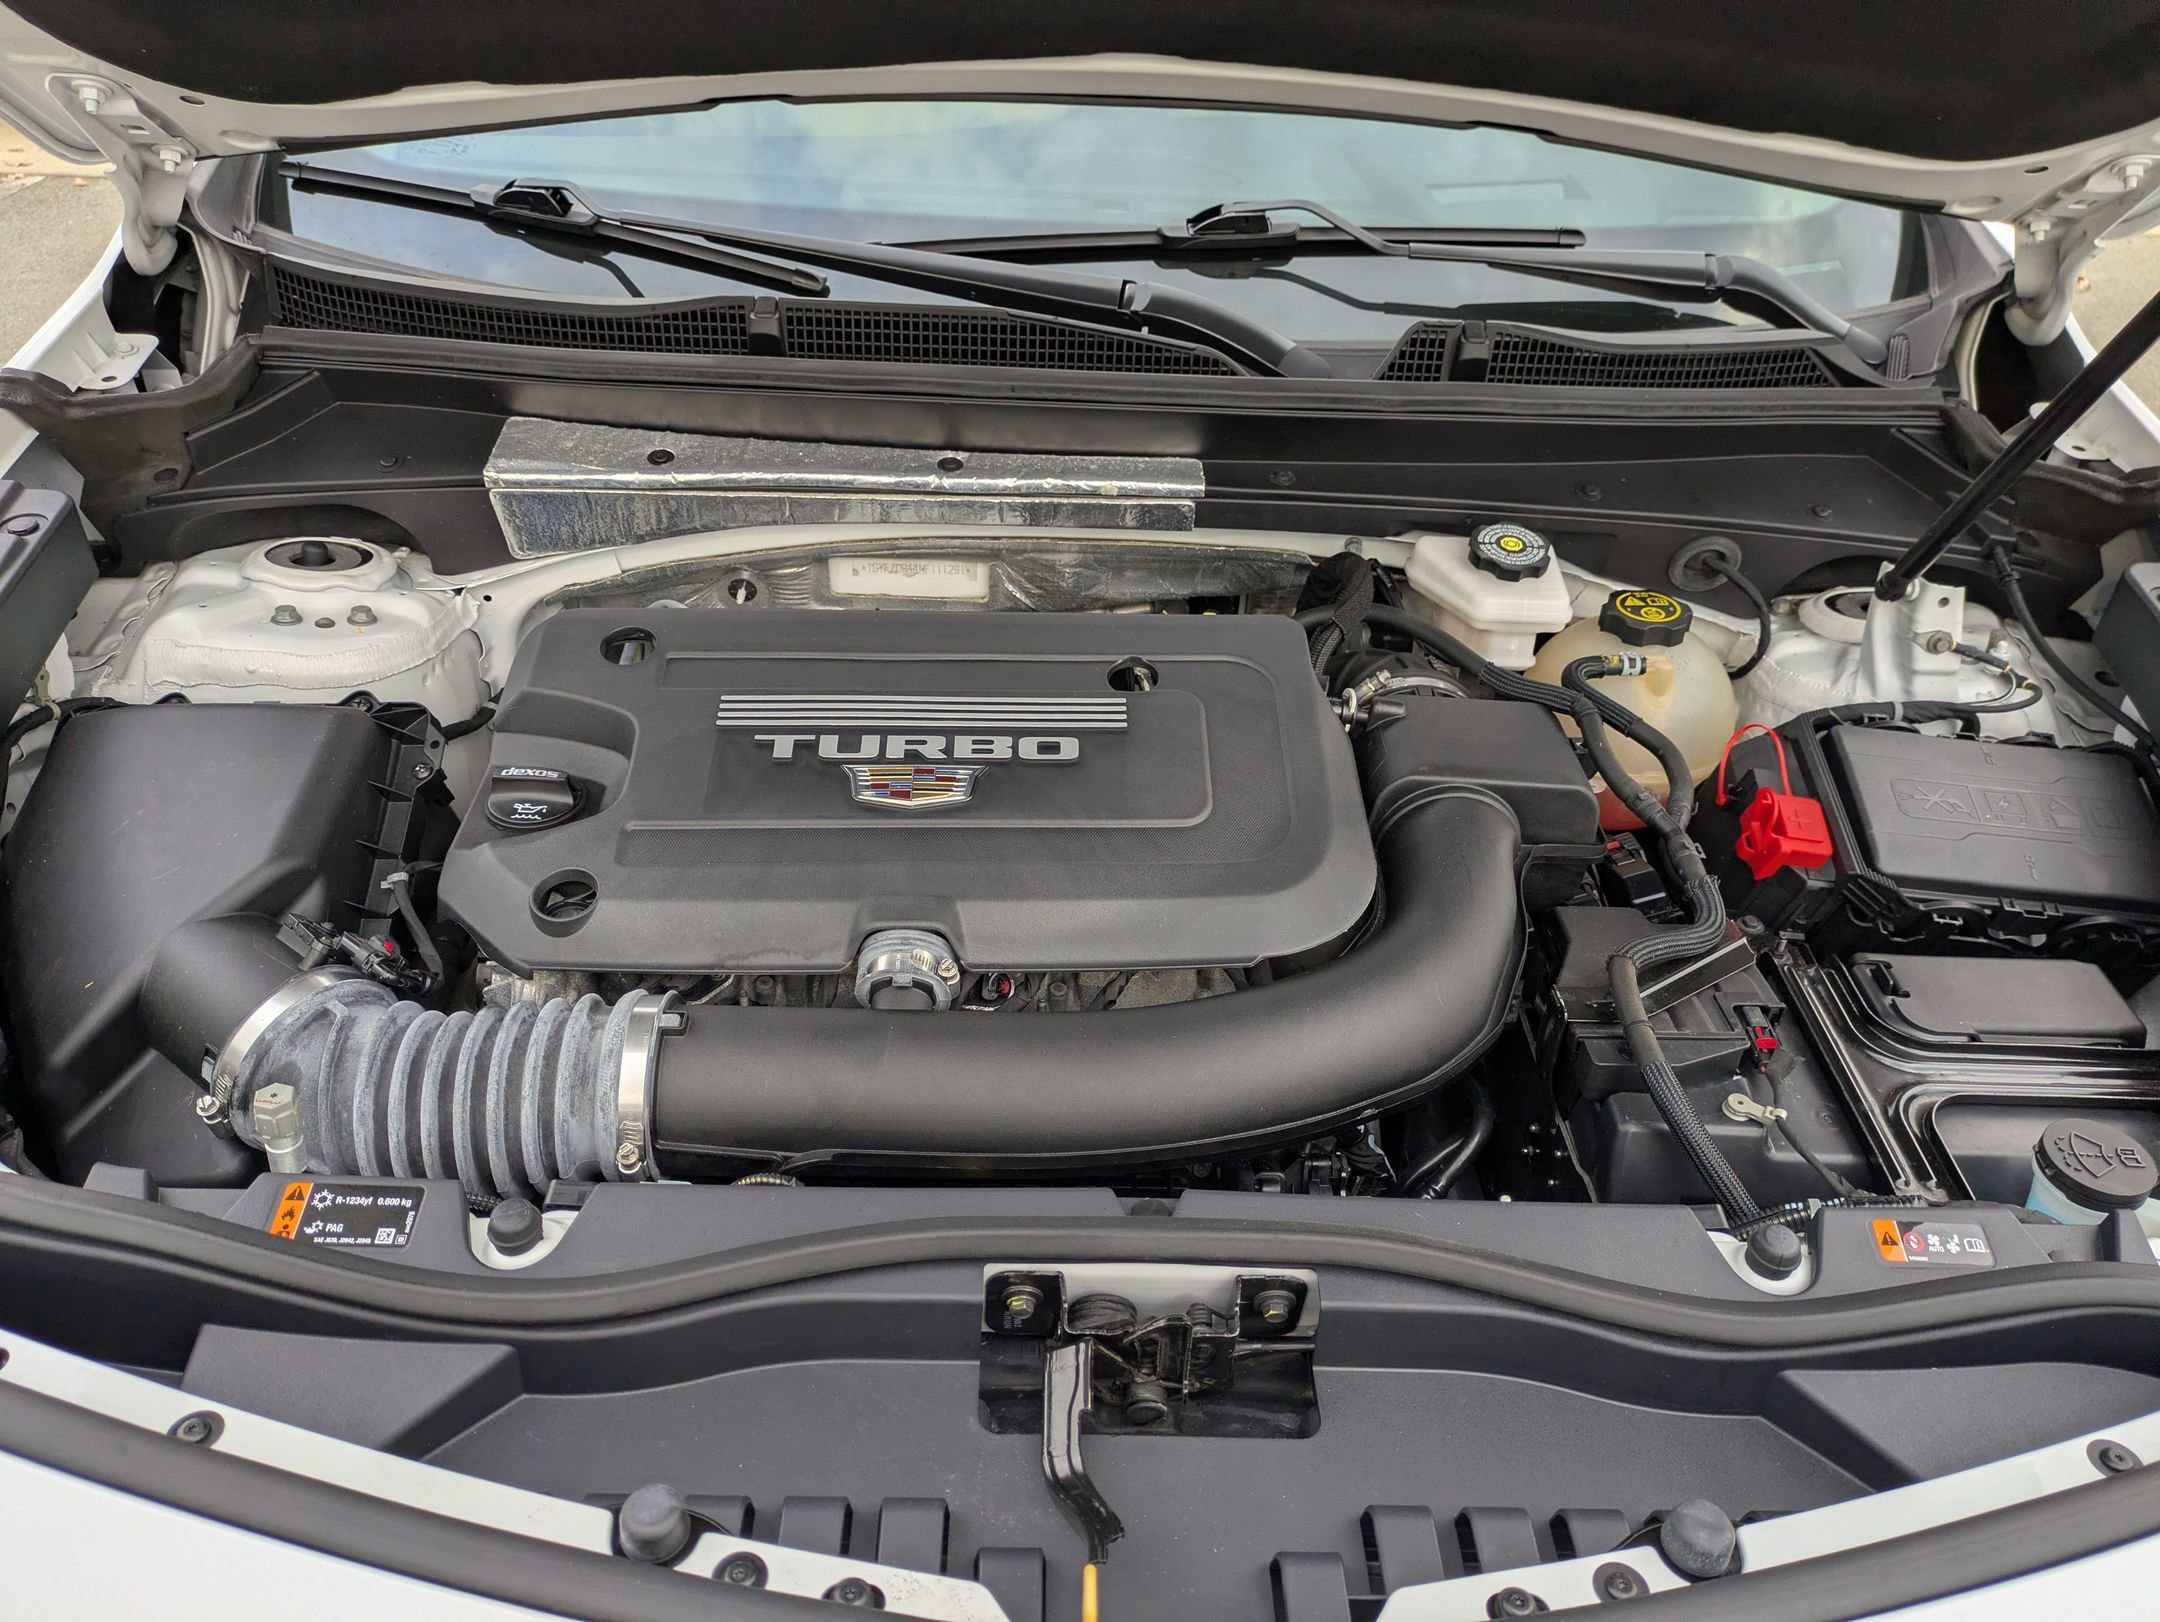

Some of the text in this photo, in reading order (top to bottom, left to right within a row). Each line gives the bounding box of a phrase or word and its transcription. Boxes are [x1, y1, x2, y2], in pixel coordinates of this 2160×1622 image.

[753, 734, 1081, 761] TURBO
[501, 767, 560, 778] dexos
[335, 1196, 413, 1208] R-1234yf 0.600 kg
[325, 1223, 344, 1233] PAG
[1928, 1245, 1945, 1253] AUTO
